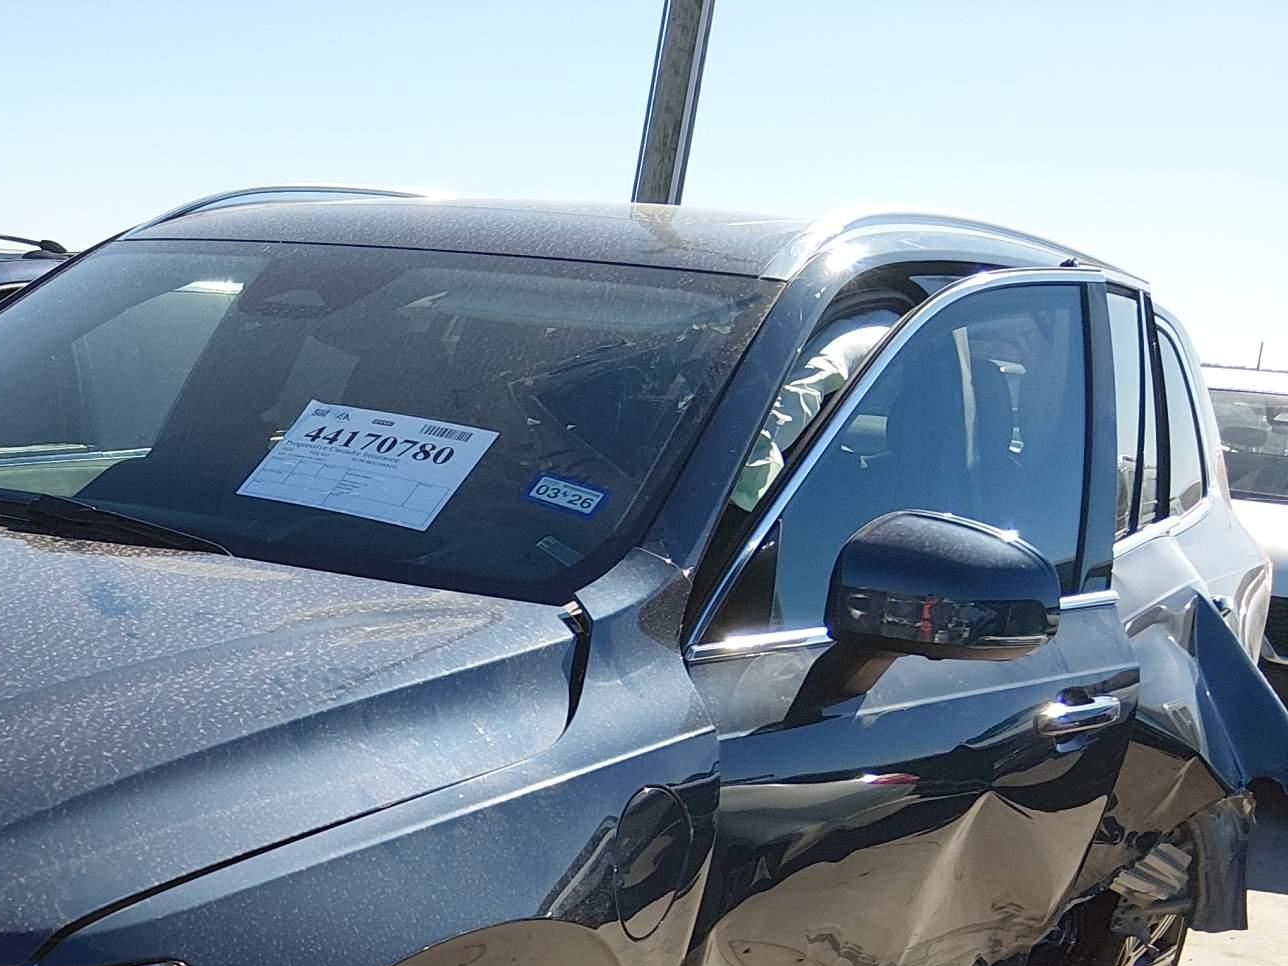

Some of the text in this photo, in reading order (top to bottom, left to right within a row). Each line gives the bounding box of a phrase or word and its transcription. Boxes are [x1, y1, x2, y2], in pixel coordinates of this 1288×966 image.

[285, 440, 328, 452] Progressive
[329, 446, 363, 457] Casualty
[363, 451, 401, 463] Insurance
[304, 425, 455, 465] 44170780
